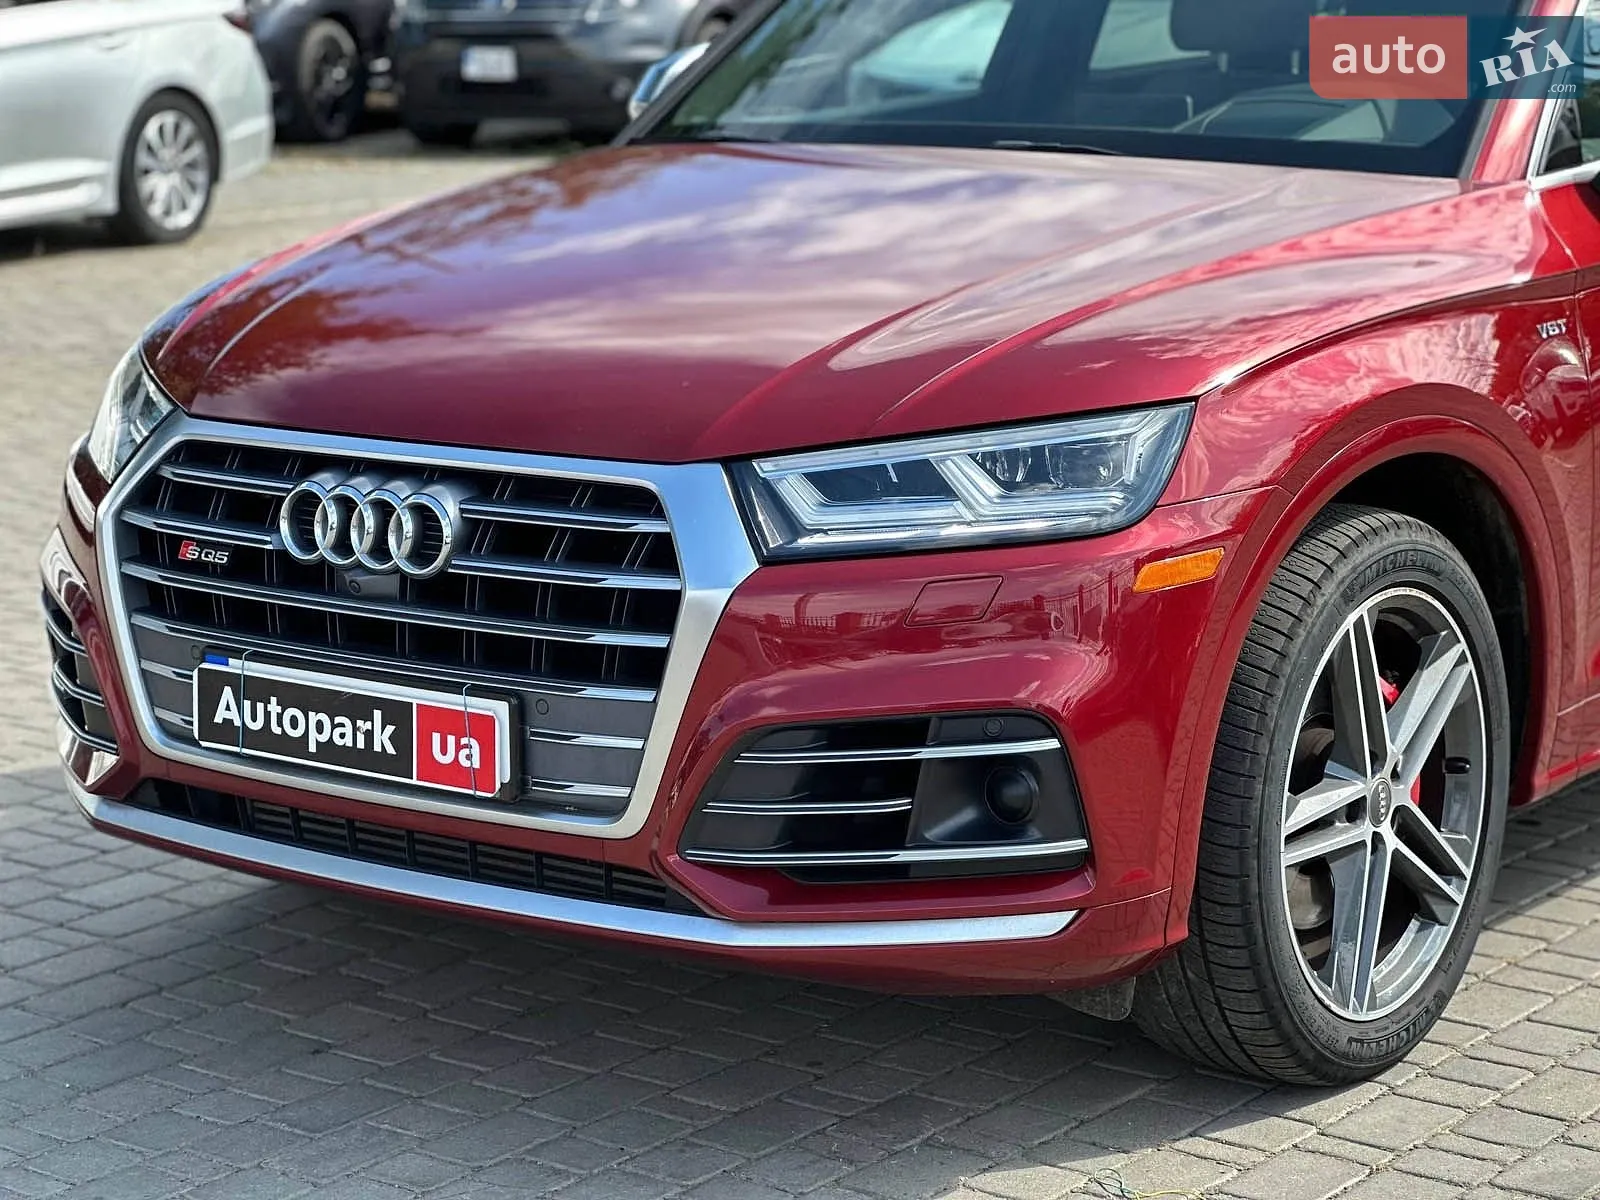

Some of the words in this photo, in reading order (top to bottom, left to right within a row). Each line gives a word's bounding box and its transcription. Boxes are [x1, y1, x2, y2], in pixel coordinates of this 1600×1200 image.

[183, 544, 229, 563] SQ5
[213, 686, 397, 755] Autopark
[431, 732, 481, 769] ua
